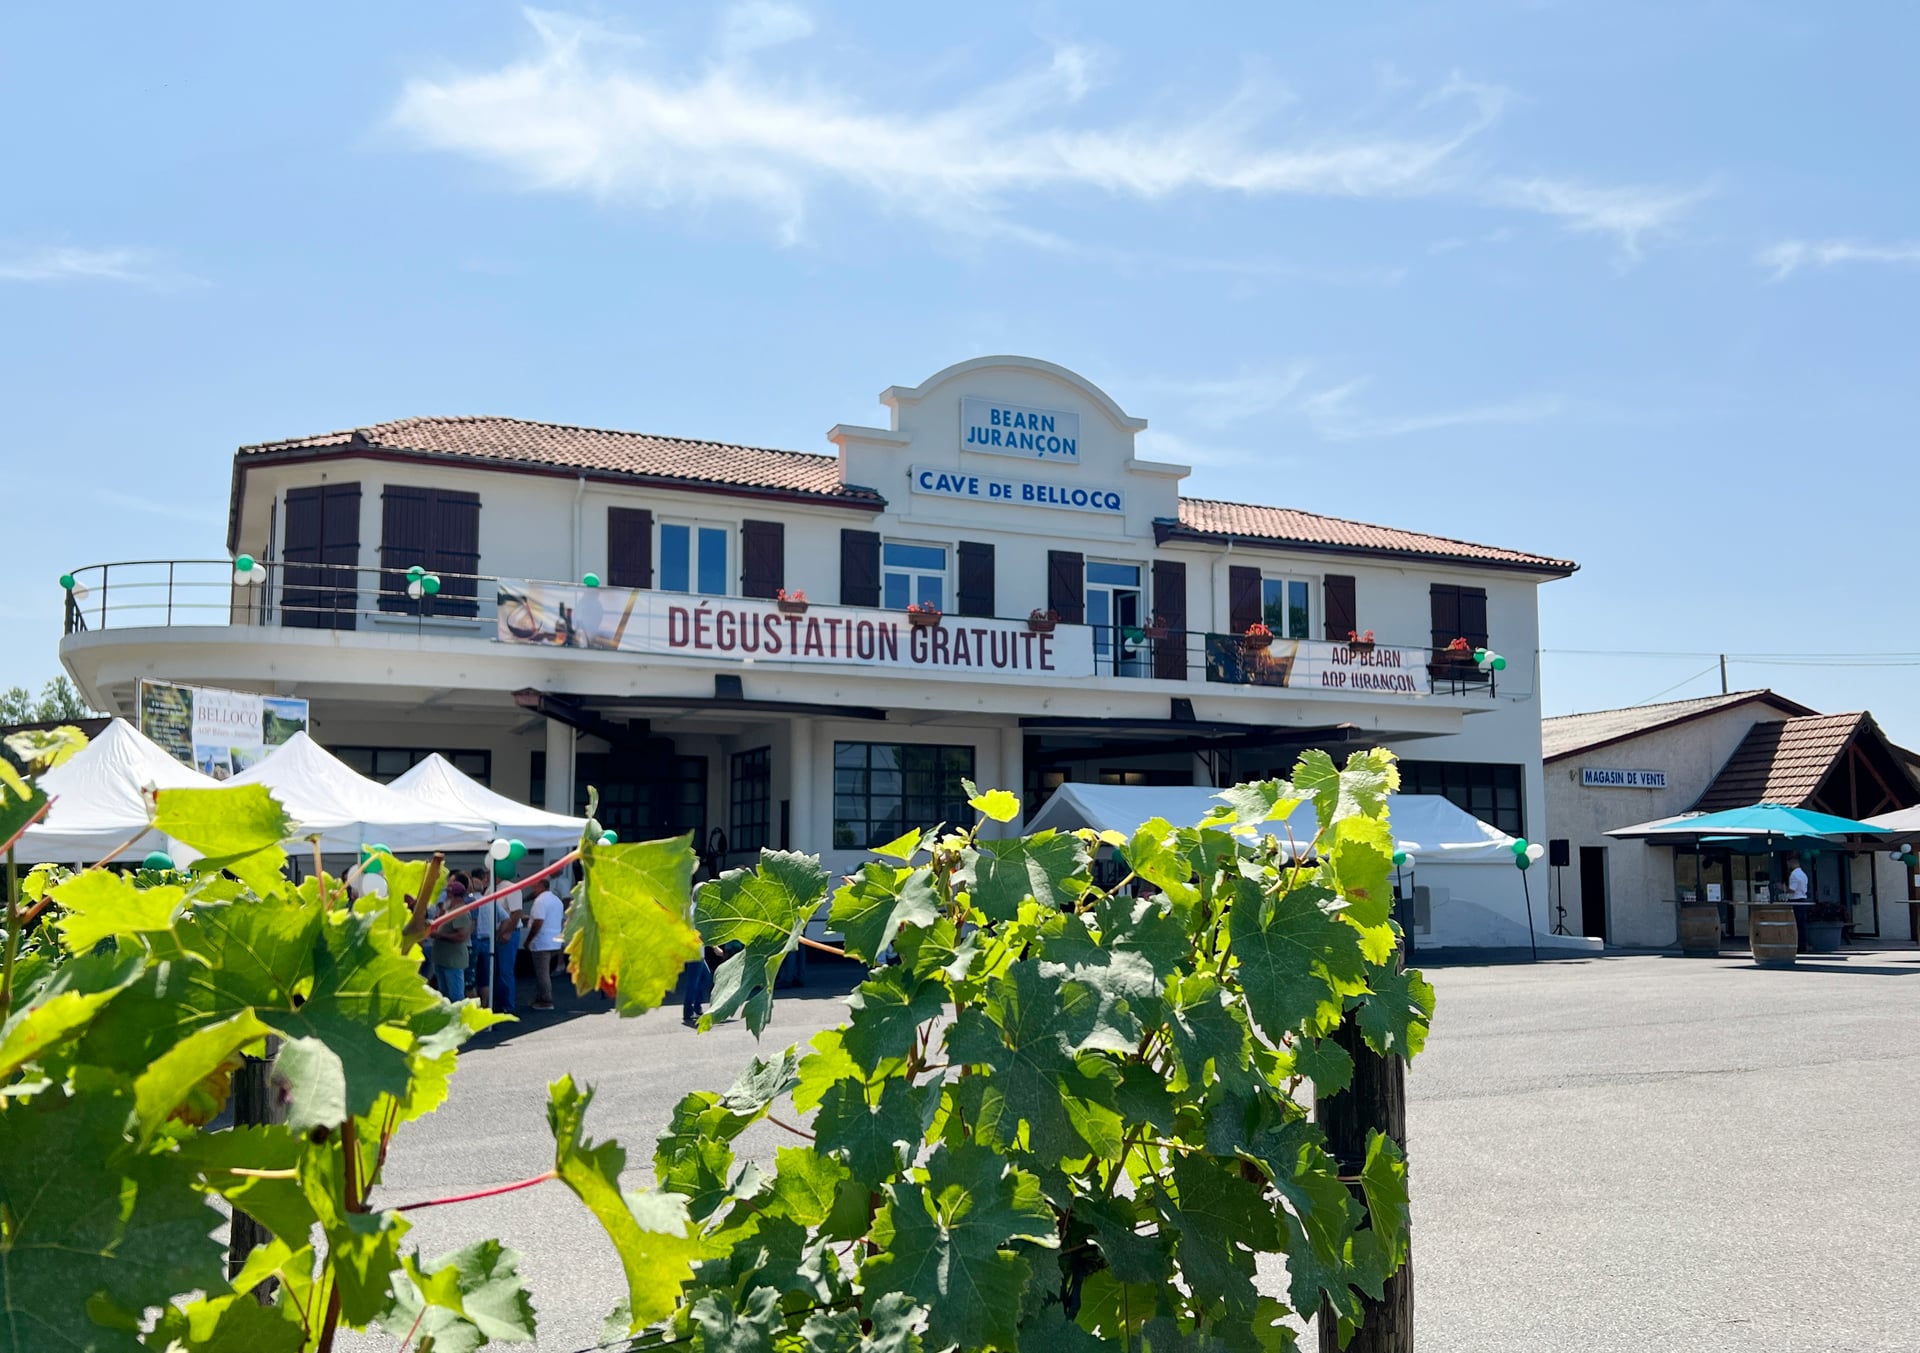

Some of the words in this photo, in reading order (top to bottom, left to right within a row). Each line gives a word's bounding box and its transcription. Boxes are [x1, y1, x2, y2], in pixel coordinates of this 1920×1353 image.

[990, 408, 1055, 433] BEARN
[967, 426, 1077, 458] JURANÇON
[919, 471, 979, 495] CAVE
[989, 482, 1012, 499] DE
[1022, 483, 1121, 511] BELLOCQ
[668, 600, 898, 661] DÉGUSTATION
[910, 624, 1056, 670] GRATUITE
[1332, 647, 1357, 666] AOP
[1360, 648, 1401, 668] BEARN
[1322, 670, 1346, 688] AOP
[198, 705, 258, 728] BELLOCQ
[1585, 770, 1624, 784] MAGASIN
[1627, 772, 1637, 784] DE
[1640, 773, 1666, 786] VENTE
